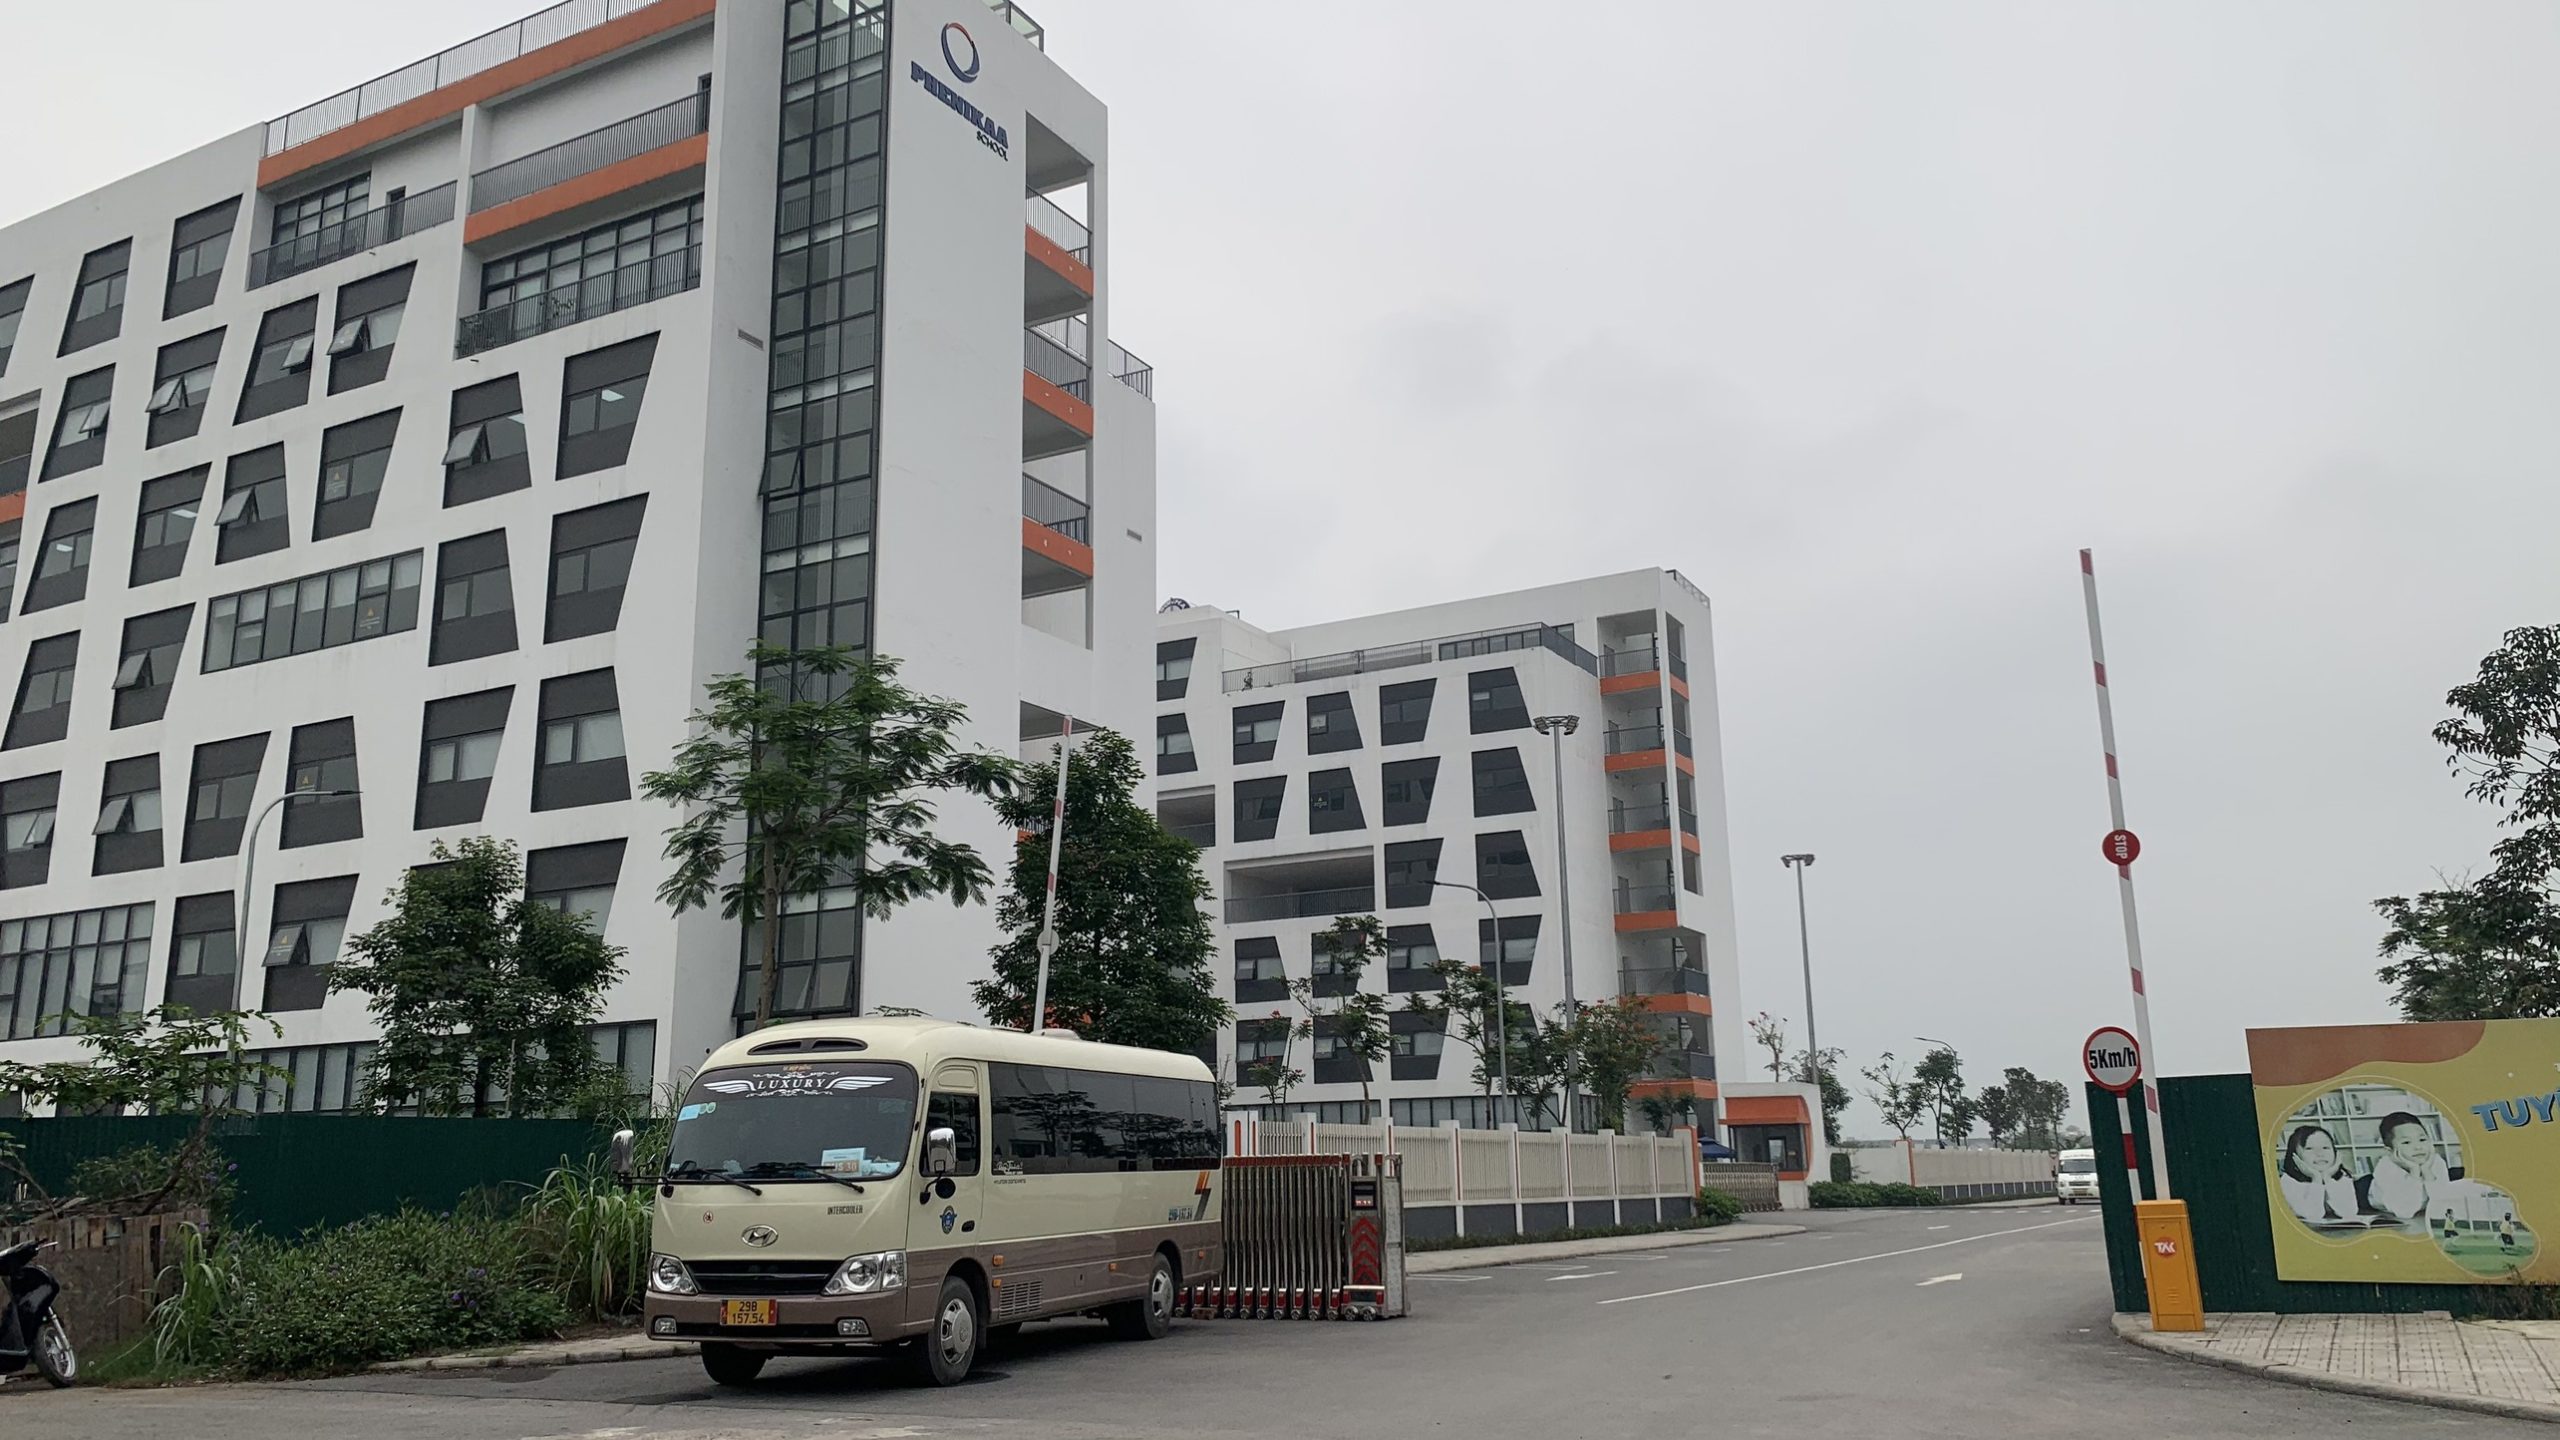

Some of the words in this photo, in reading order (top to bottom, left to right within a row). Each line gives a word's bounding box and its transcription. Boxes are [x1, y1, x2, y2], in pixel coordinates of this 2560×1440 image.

[911, 61, 1008, 149] PHENIKAA
[976, 131, 1008, 161] SCHOOL
[2114, 834, 2128, 860] STOP
[2088, 1046, 2137, 1070] 5Km/h
[757, 1078, 826, 1090] LUXURY
[732, 1312, 764, 1324] 157.54
[739, 1301, 758, 1312] 29B
